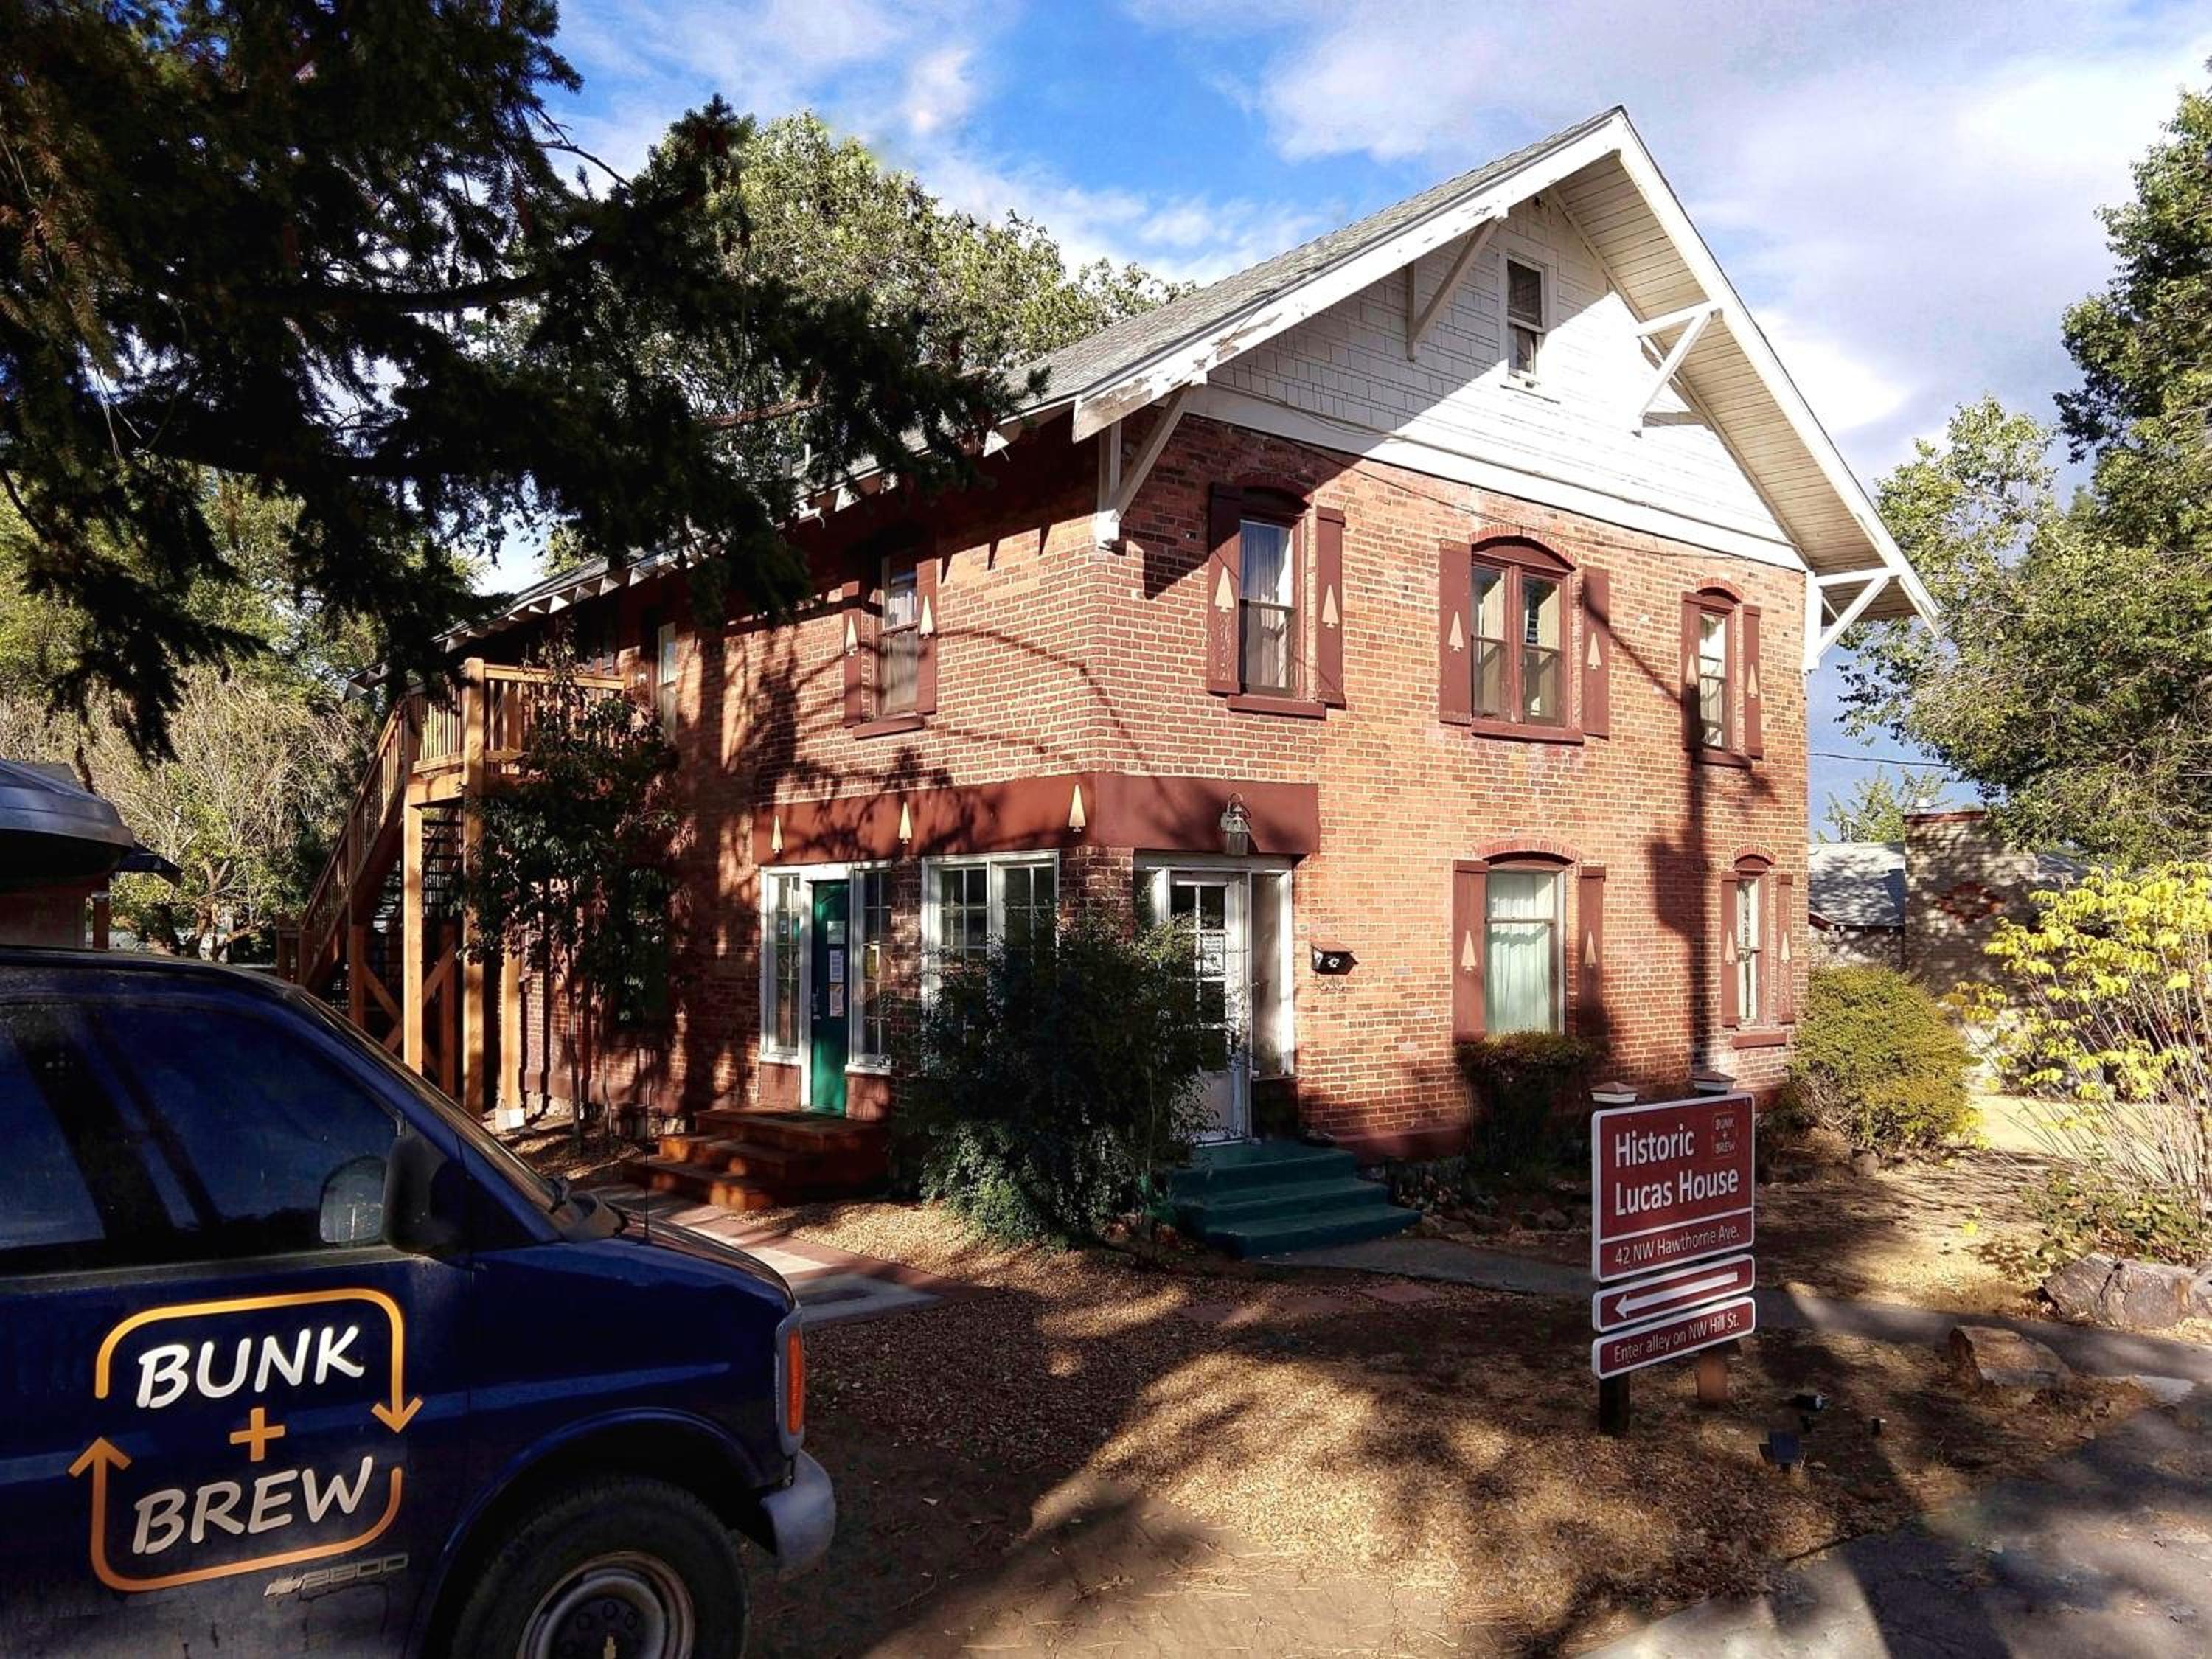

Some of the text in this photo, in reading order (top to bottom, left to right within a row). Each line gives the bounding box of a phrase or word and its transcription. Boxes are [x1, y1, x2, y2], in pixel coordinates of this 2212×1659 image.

[1615, 1123, 1695, 1168] Historic
[1615, 1169, 1739, 1216] Lucas House
[1615, 1225, 1739, 1265] 42 NW Hawthorne Ave.
[1614, 1312, 1739, 1363] Enter alley on NW Hill St.
[136, 1325, 365, 1409] BUNK
[132, 1455, 373, 1555] BREW
